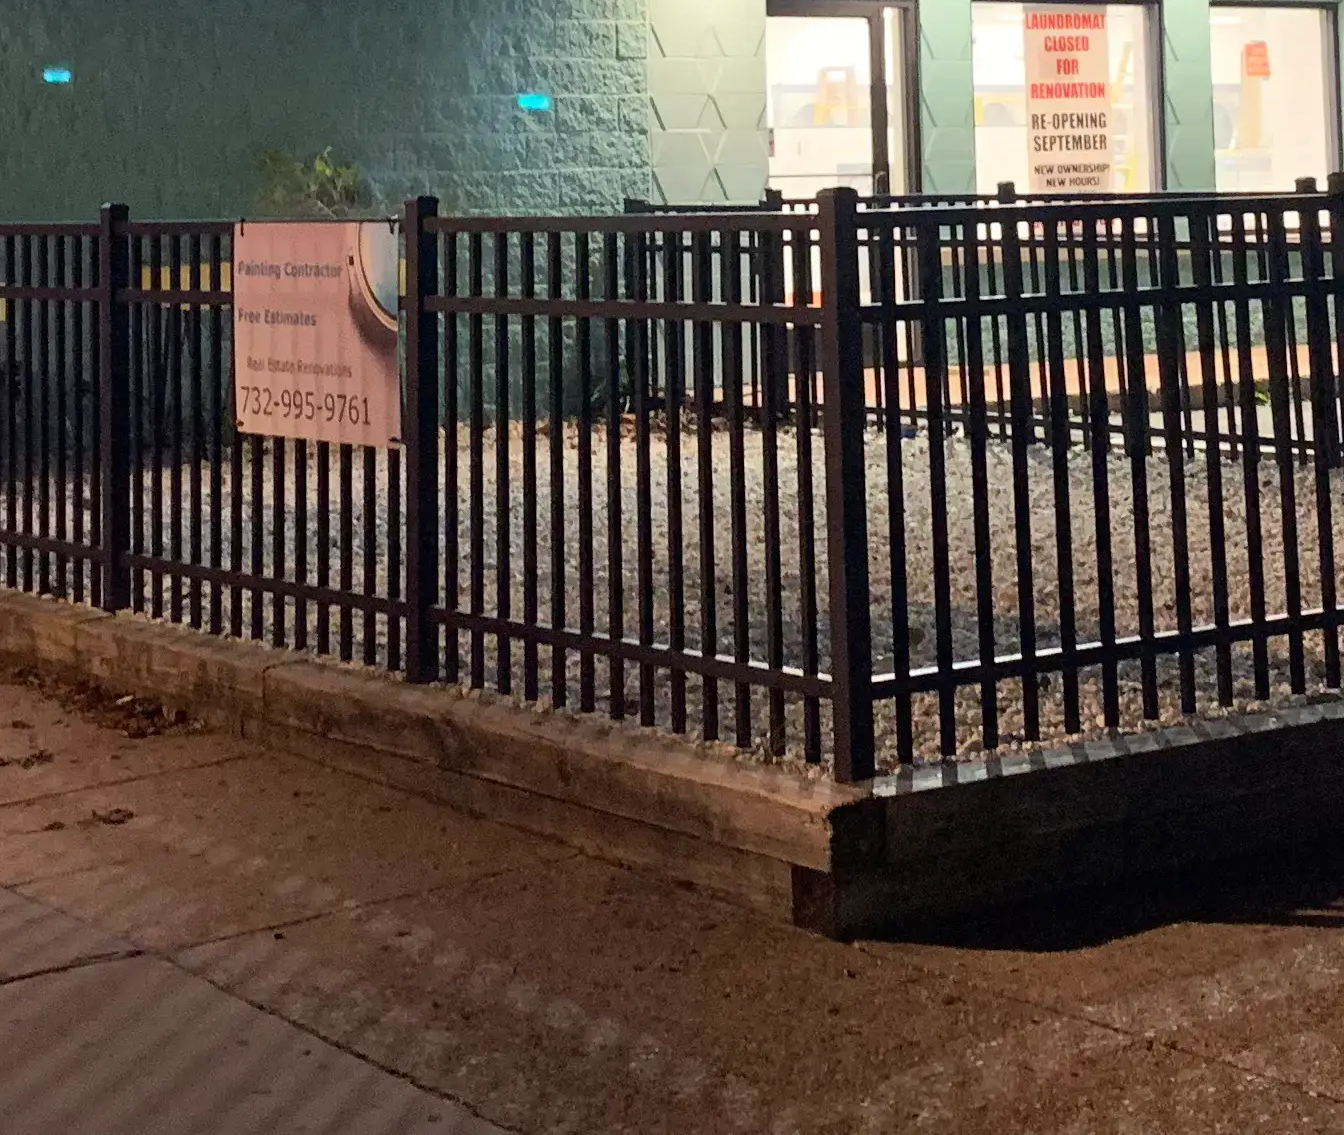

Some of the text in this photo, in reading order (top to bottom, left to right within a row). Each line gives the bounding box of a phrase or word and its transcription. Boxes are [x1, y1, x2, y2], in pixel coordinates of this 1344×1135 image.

[1025, 13, 1106, 30] LAUNDROMAT
[1044, 36, 1089, 53] CLOSED
[1056, 58, 1079, 75] FOR
[1030, 82, 1105, 99] RENOVATION
[1031, 112, 1107, 130] RE-OPENING
[1033, 134, 1107, 152] SEPTEMBER
[1034, 165, 1054, 175] NEW
[1046, 177, 1100, 187] NEW HOURS!
[238, 261, 342, 280] Painting Contractor
[238, 309, 316, 326] Free Estimates
[241, 386, 371, 426] 732-995-9761
